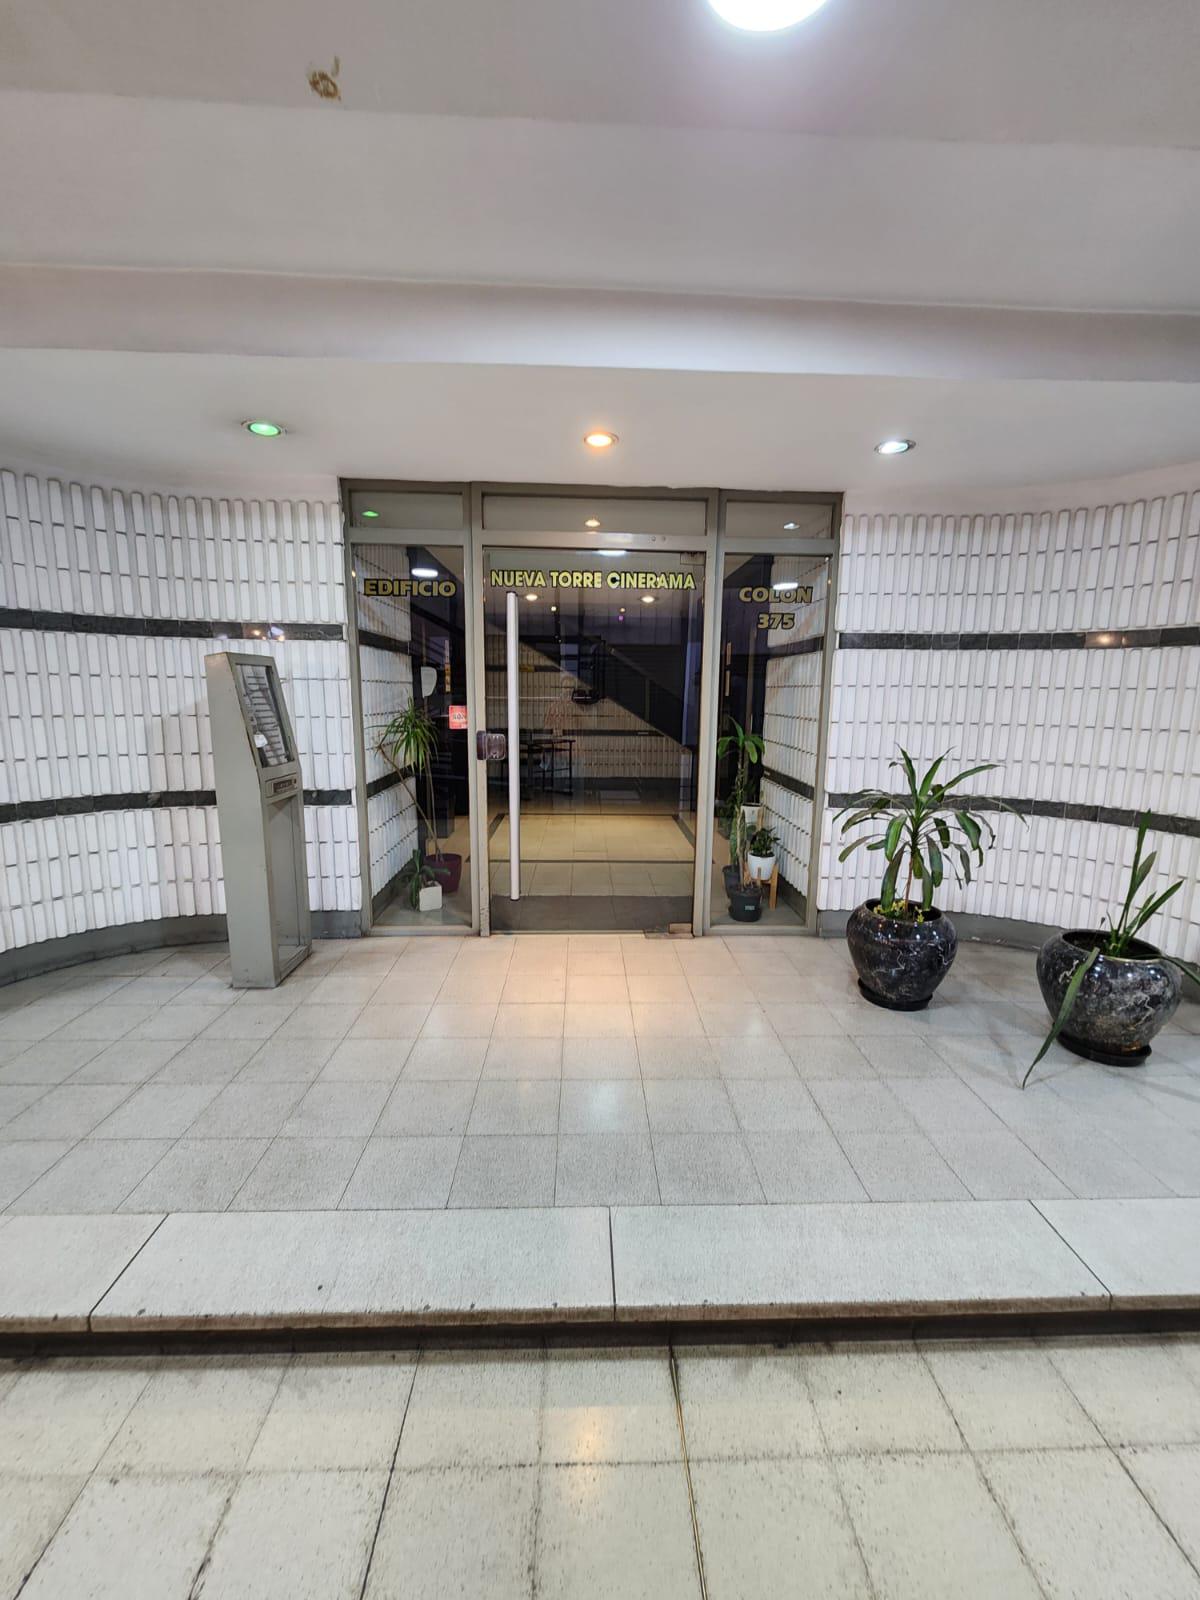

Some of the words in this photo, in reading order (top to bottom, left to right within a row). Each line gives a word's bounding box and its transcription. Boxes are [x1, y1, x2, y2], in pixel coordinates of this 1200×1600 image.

[364, 578, 456, 598] EDIFICIO
[491, 569, 546, 588] NUEVA
[549, 571, 602, 589] TORRE
[607, 571, 696, 590] CINERAMA
[739, 586, 813, 604] COLON
[757, 613, 795, 630] 375
